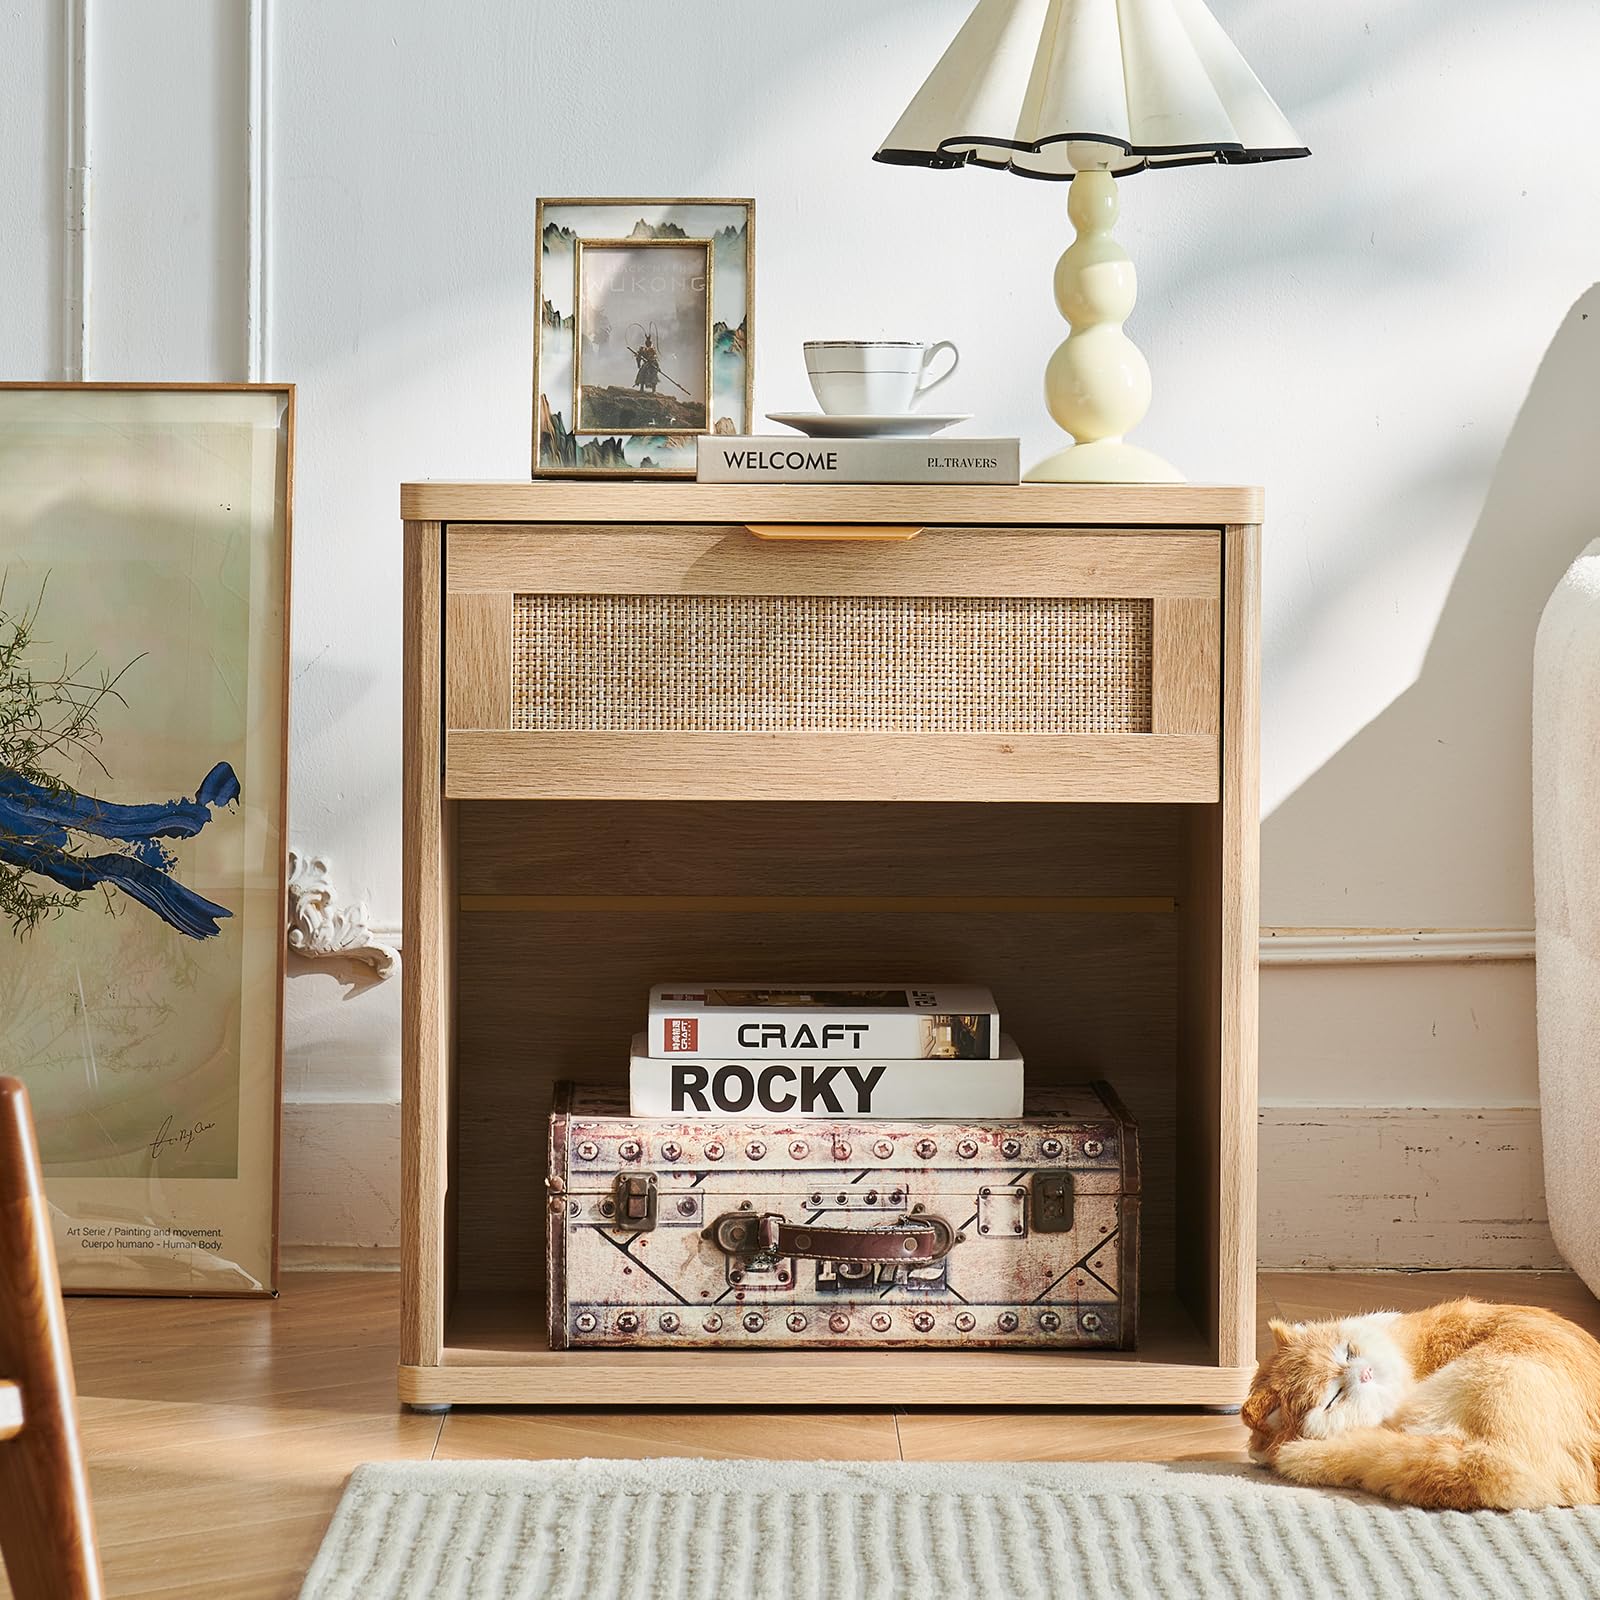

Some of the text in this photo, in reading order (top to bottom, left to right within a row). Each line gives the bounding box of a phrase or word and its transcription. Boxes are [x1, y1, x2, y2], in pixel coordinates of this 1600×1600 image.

[723, 451, 837, 471] WELCOME
[737, 1023, 870, 1049] CRAFT
[670, 1064, 887, 1114] ROCKY
[67, 1227, 81, 1236] Art
[82, 1227, 106, 1236] Serie
[114, 1227, 152, 1239] Painting
[153, 1227, 171, 1237] and
[172, 1227, 224, 1238] movement.
[81, 1239, 115, 1251] Cuerpo
[116, 1239, 155, 1249] humano
[162, 1240, 198, 1249] Human
[198, 1240, 224, 1251] Body.
